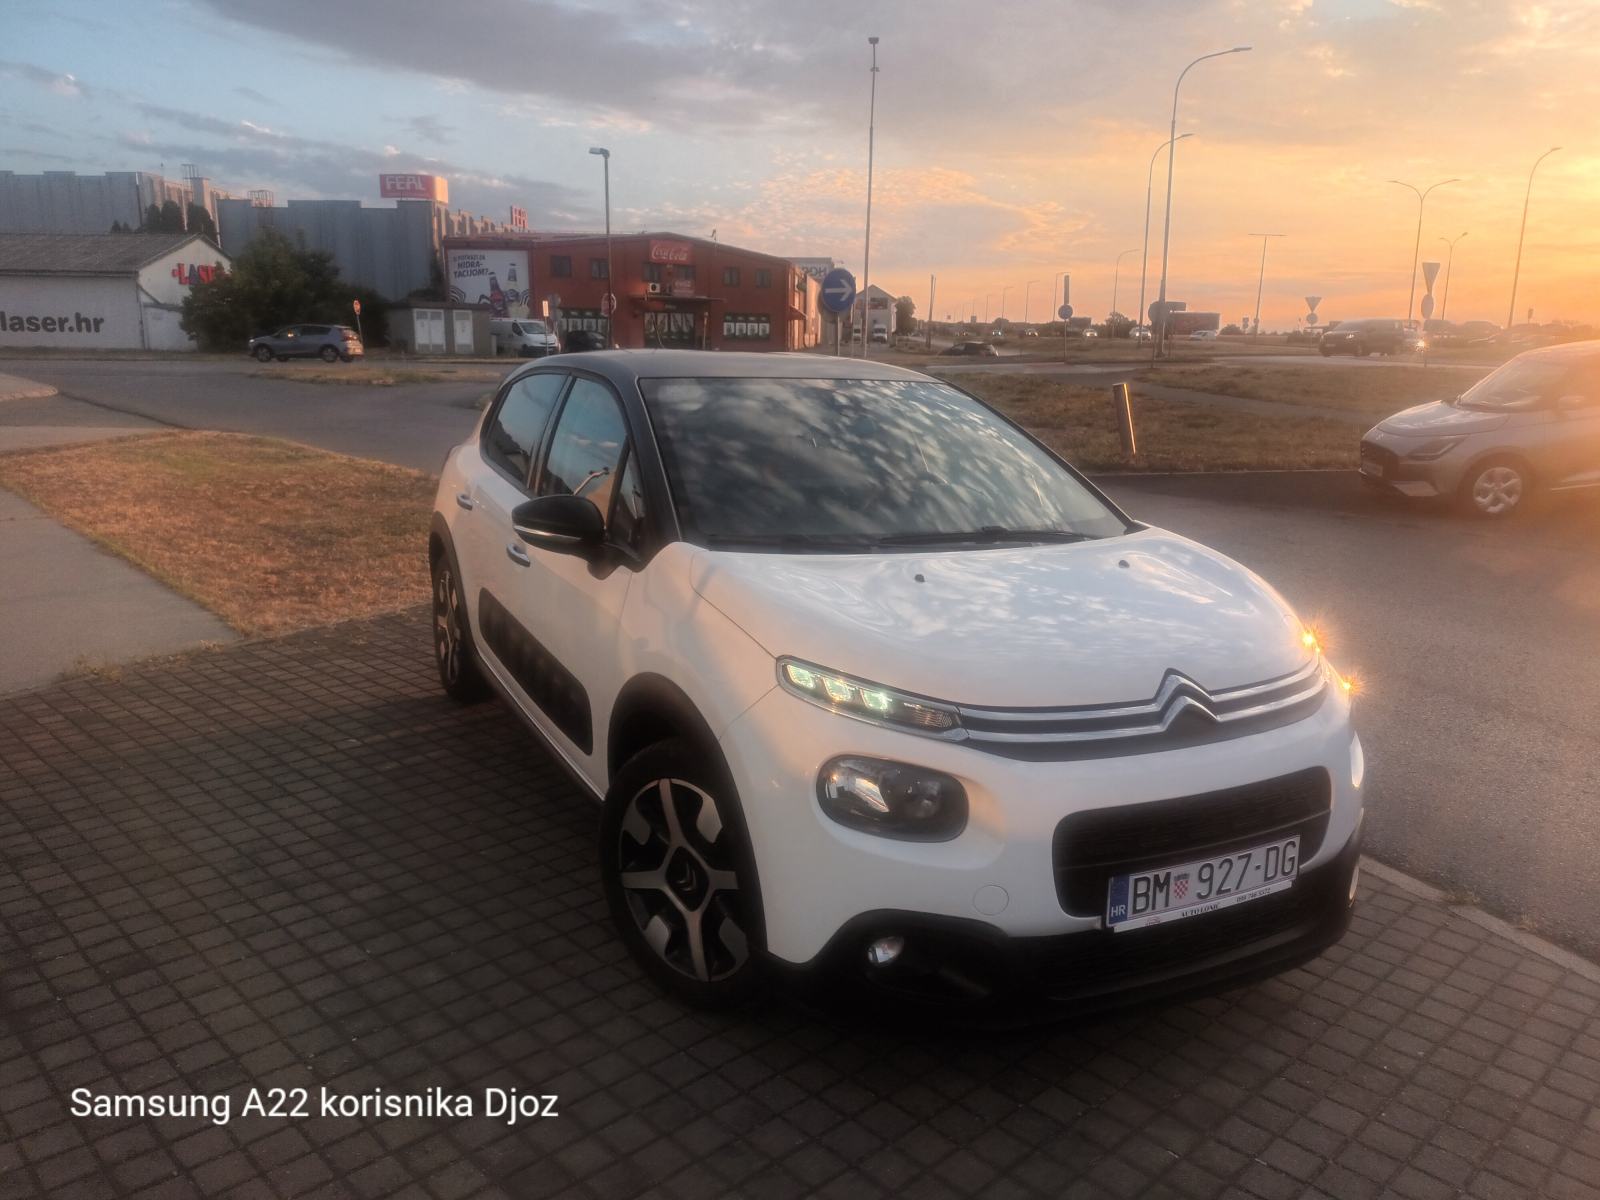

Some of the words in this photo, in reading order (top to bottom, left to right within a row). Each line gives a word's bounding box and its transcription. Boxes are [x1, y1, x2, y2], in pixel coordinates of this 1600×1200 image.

[0, 312, 104, 333] laser.hr
[1132, 871, 1172, 915] BM
[1196, 840, 1297, 900] 927-DG
[1111, 905, 1127, 918] HR
